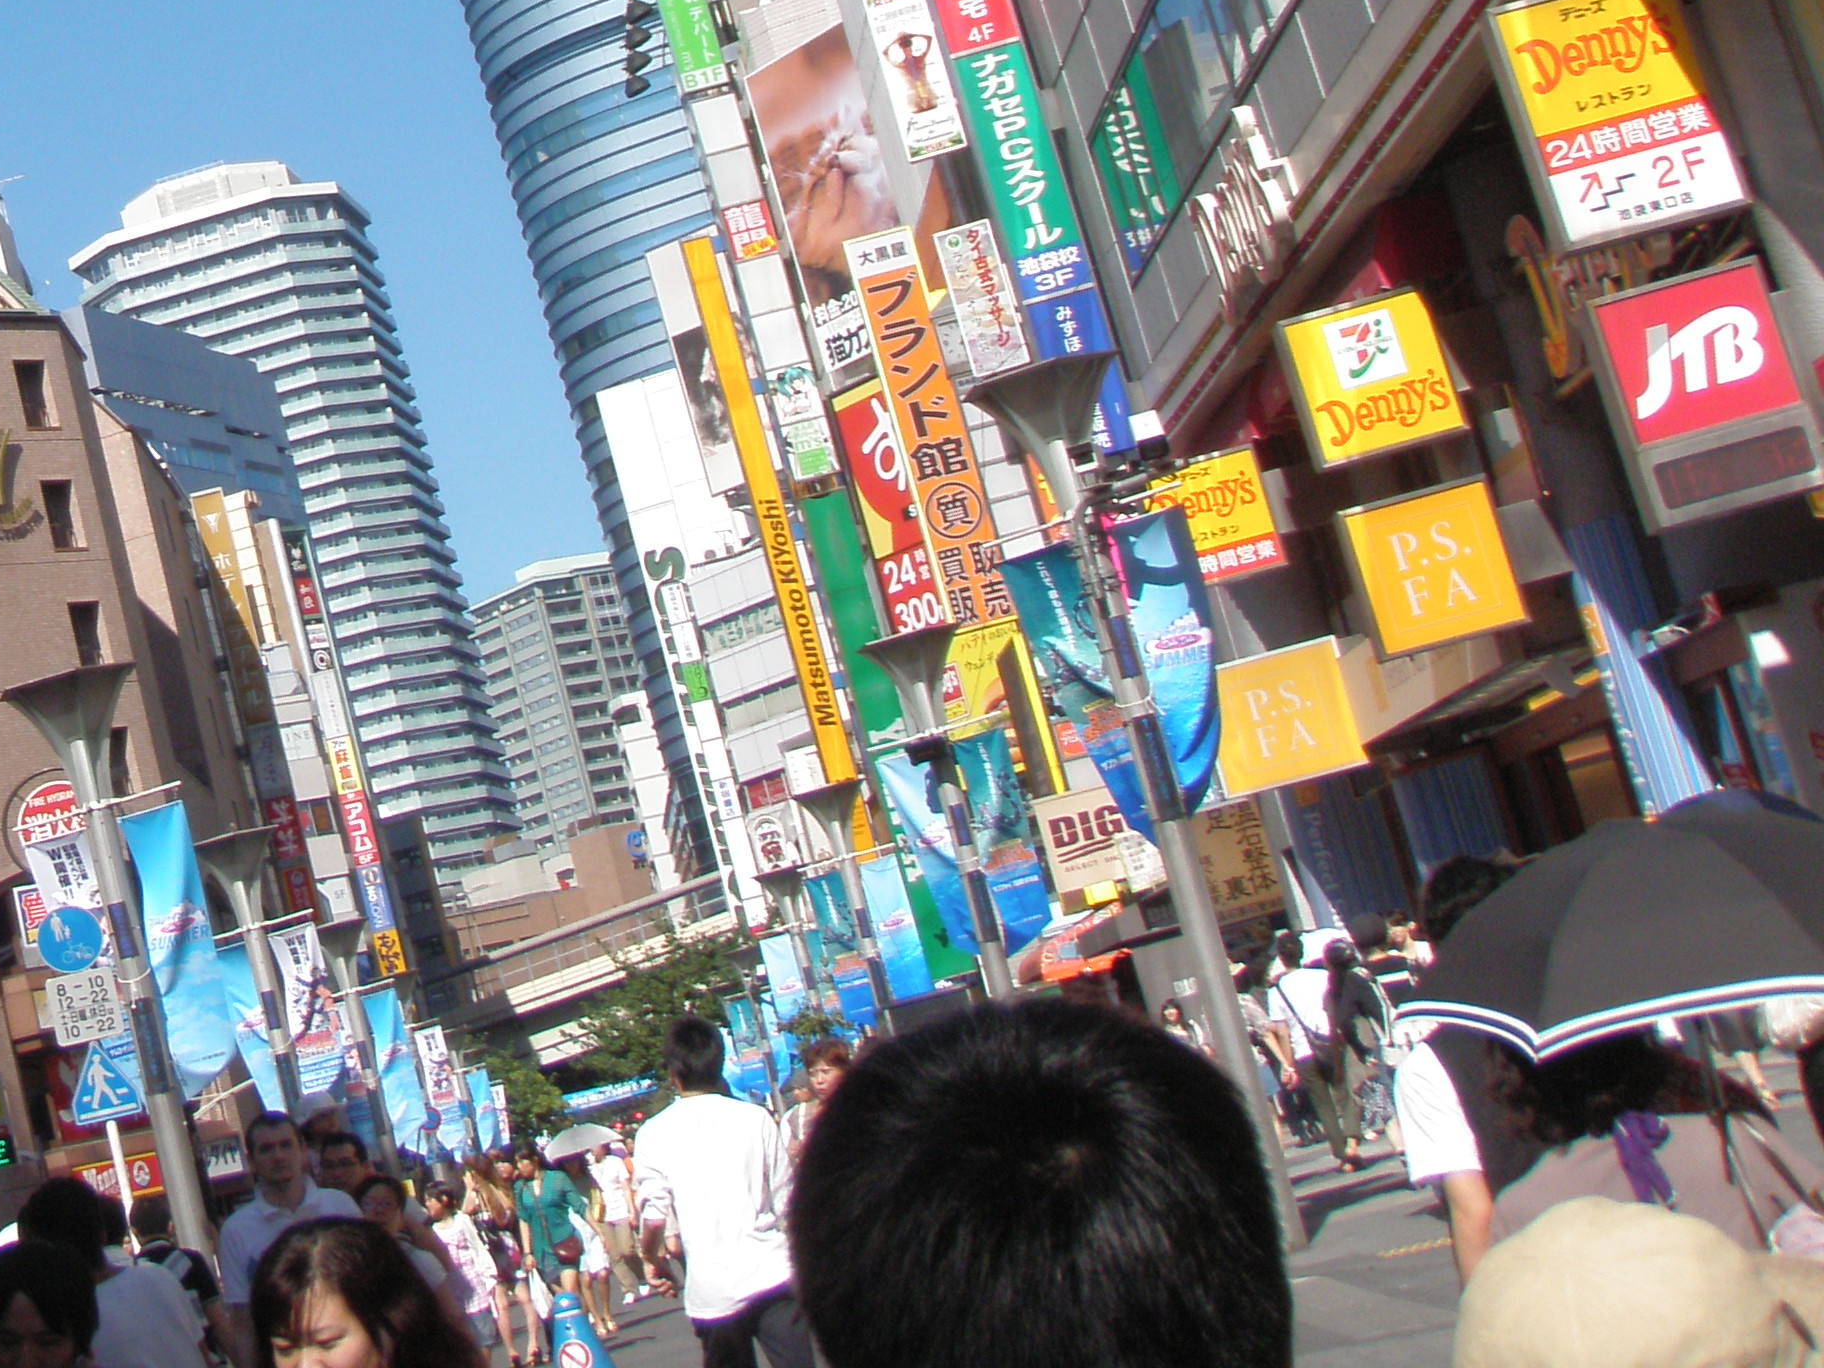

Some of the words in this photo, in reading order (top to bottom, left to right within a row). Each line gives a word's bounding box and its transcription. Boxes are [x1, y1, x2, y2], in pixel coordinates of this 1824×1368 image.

[968, 22, 995, 44] 4F
[1515, 3, 1678, 95] Denny's
[684, 65, 725, 90] B1F
[1576, 83, 1652, 112] レストラン
[971, 52, 1063, 252] ナガセPCスクール
[1546, 102, 1713, 168] 24時間営業
[1651, 149, 1706, 190] 2F
[1618, 190, 1694, 221] 池袋東口店
[858, 240, 908, 267] 大黒屋
[1018, 246, 1081, 276] 池袋校
[966, 229, 1011, 348] タイ古式マッサージ
[1035, 267, 1075, 291] 3F
[1054, 305, 1084, 354] みずほ
[867, 271, 972, 479] ブランド館
[1635, 305, 1765, 421] JTB
[1315, 371, 1451, 448] Denny's
[936, 490, 975, 532] 質
[1392, 521, 1476, 575] P.S.
[882, 553, 918, 594] 24
[790, 583, 839, 727] Matsumoto
[1247, 679, 1313, 724] P.S.
[28, 795, 47, 810] FIRE
[46, 789, 76, 806] HYDRAN
[342, 801, 375, 852] アコム
[1047, 804, 1126, 850] DIG
[358, 852, 375, 866] 5F
[1064, 858, 1099, 873] SELECT
